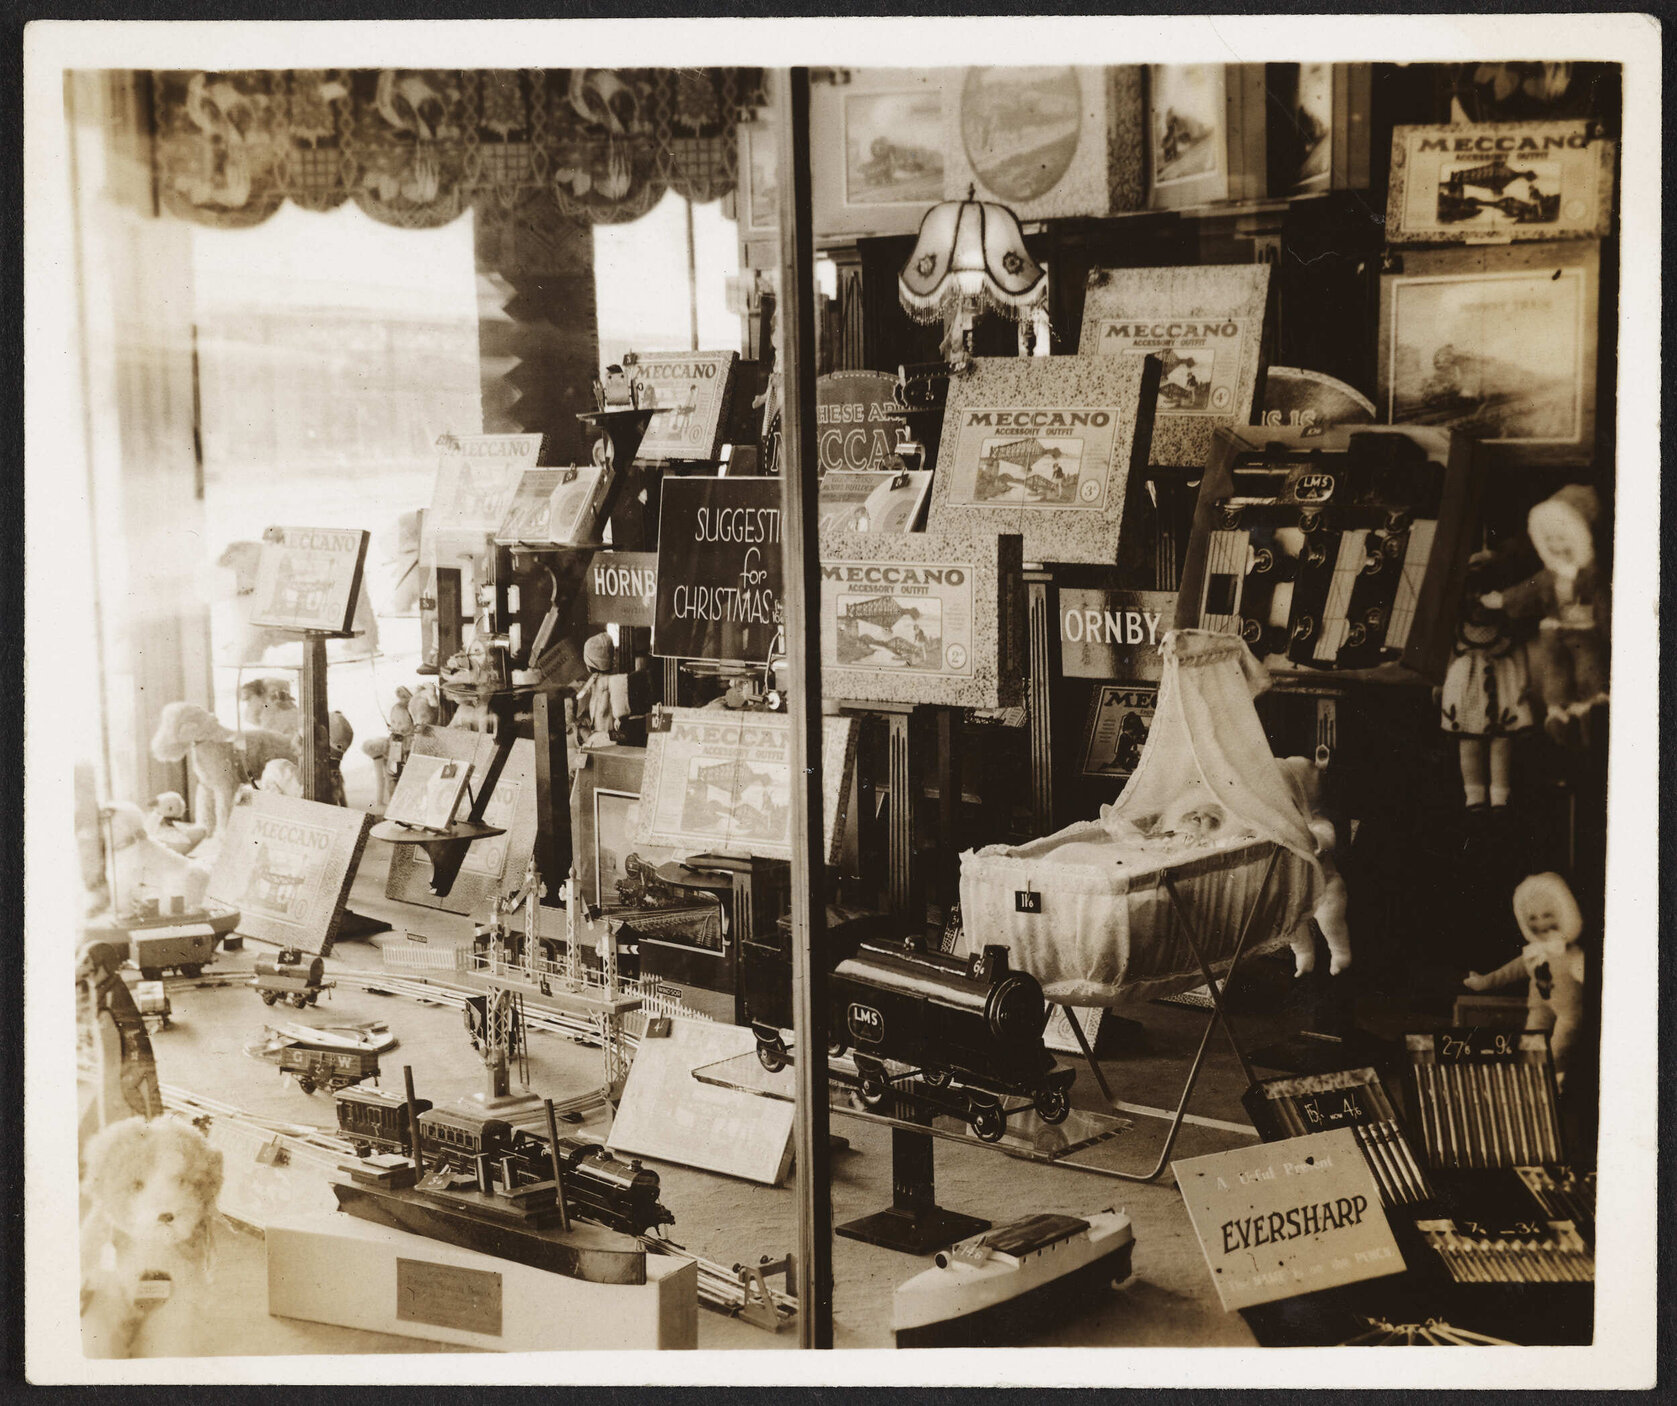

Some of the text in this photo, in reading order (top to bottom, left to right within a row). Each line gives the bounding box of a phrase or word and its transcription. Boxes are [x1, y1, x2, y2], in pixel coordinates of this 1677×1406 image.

[1418, 136, 1590, 152] MECCANO
[1104, 323, 1239, 338] MECCANO
[1132, 338, 1207, 347] ACCESSORY OUTFIT
[635, 363, 718, 379] MECCANO
[815, 404, 865, 424] HESE
[967, 412, 1110, 428] MECCANO
[994, 427, 1075, 436] ACCESSORY OUTFIT
[1303, 475, 1329, 488] LMS
[695, 507, 784, 542] SUGGESTI
[740, 547, 767, 588] for
[820, 566, 966, 586] MECCANO
[594, 567, 657, 597] HORNB
[847, 584, 930, 595] ACCESSORY OUTFIT
[674, 585, 773, 624] CHRISTMAS
[1059, 608, 1161, 645] ORNBY
[670, 724, 790, 750] MECCAN
[854, 1006, 879, 1026] LMS
[1221, 1194, 1368, 1254] EVERSHARP
